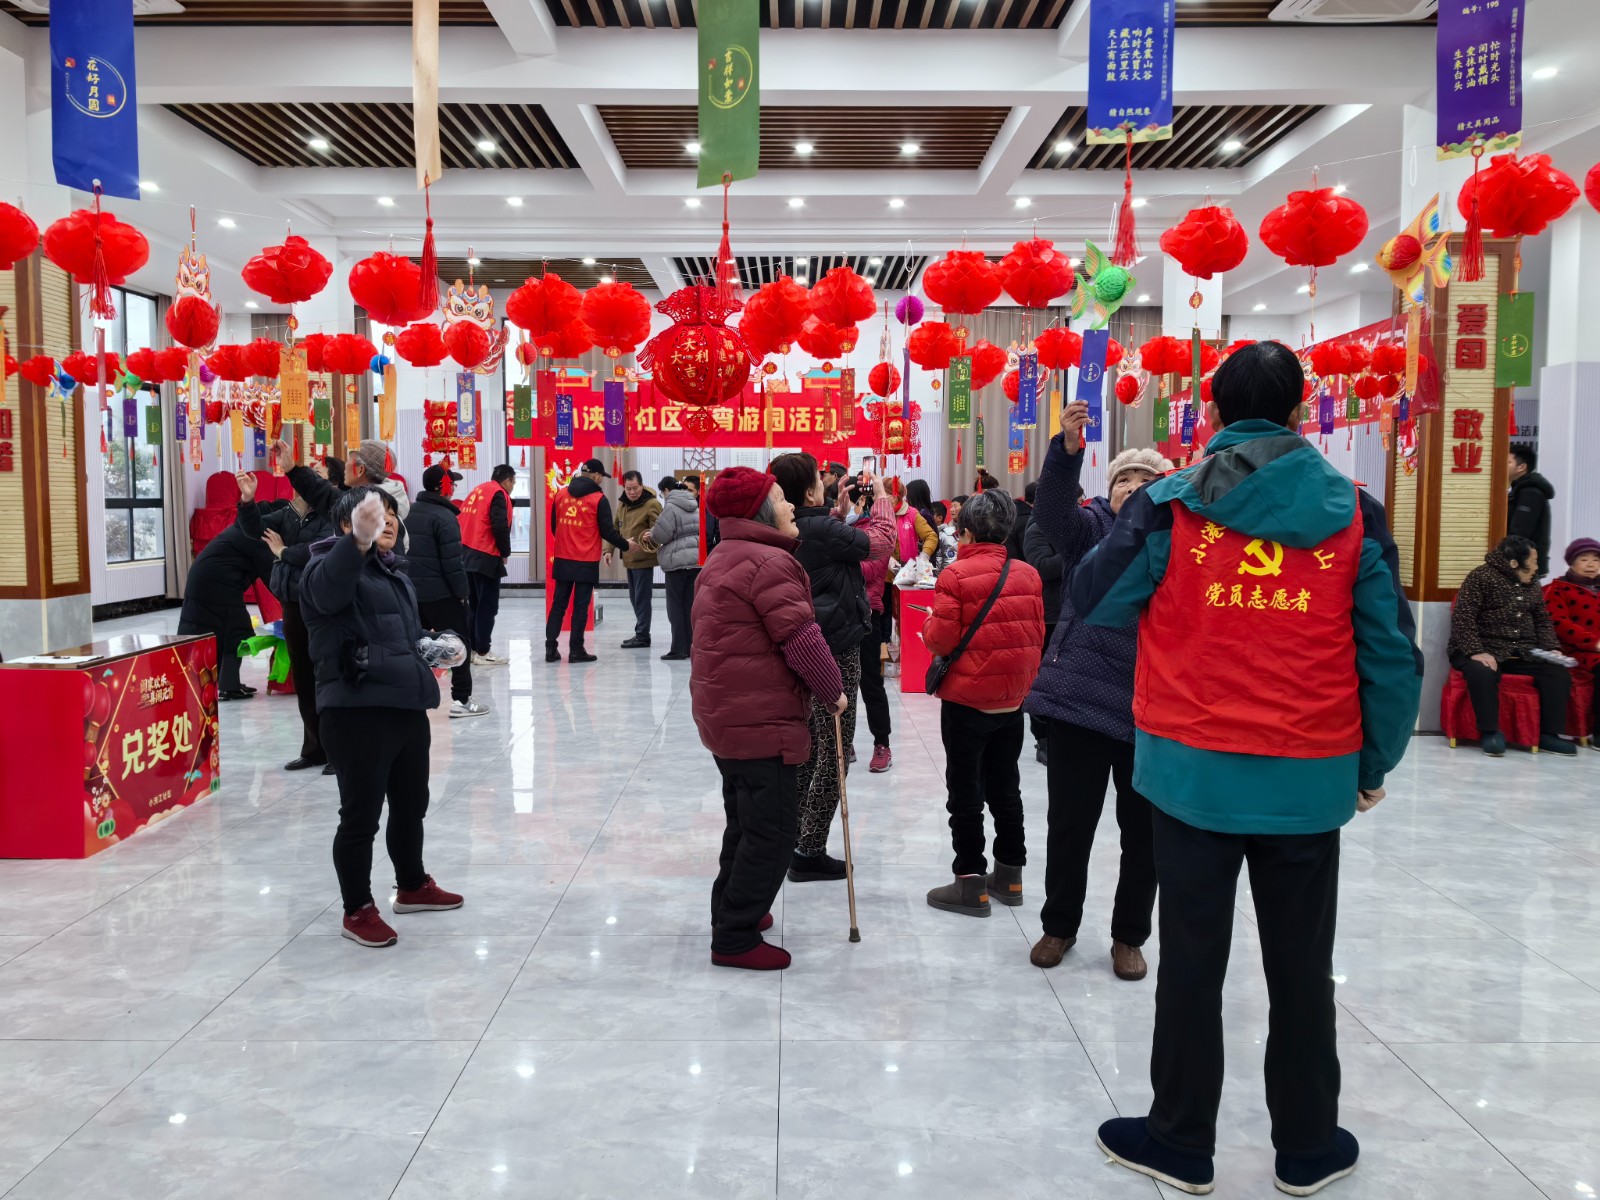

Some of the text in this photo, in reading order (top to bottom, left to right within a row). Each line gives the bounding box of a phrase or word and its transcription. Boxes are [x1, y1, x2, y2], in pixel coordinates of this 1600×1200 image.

[723, 50, 733, 103] 吉祥如意
[1106, 29, 1117, 81] 天上有面鼓
[1120, 28, 1131, 81] 藏在云里头
[1132, 28, 1142, 81] 响时先冒火
[1490, 40, 1500, 83] 忙时光头
[86, 59, 100, 111] 花好月圆
[1109, 107, 1151, 117] 猜自然现象
[1451, 304, 1488, 473] 爱国 敬业
[573, 406, 837, 431] 浃社区宵游园活动
[1205, 582, 1311, 613] 党员志愿者
[121, 711, 193, 780] 兑奖处
